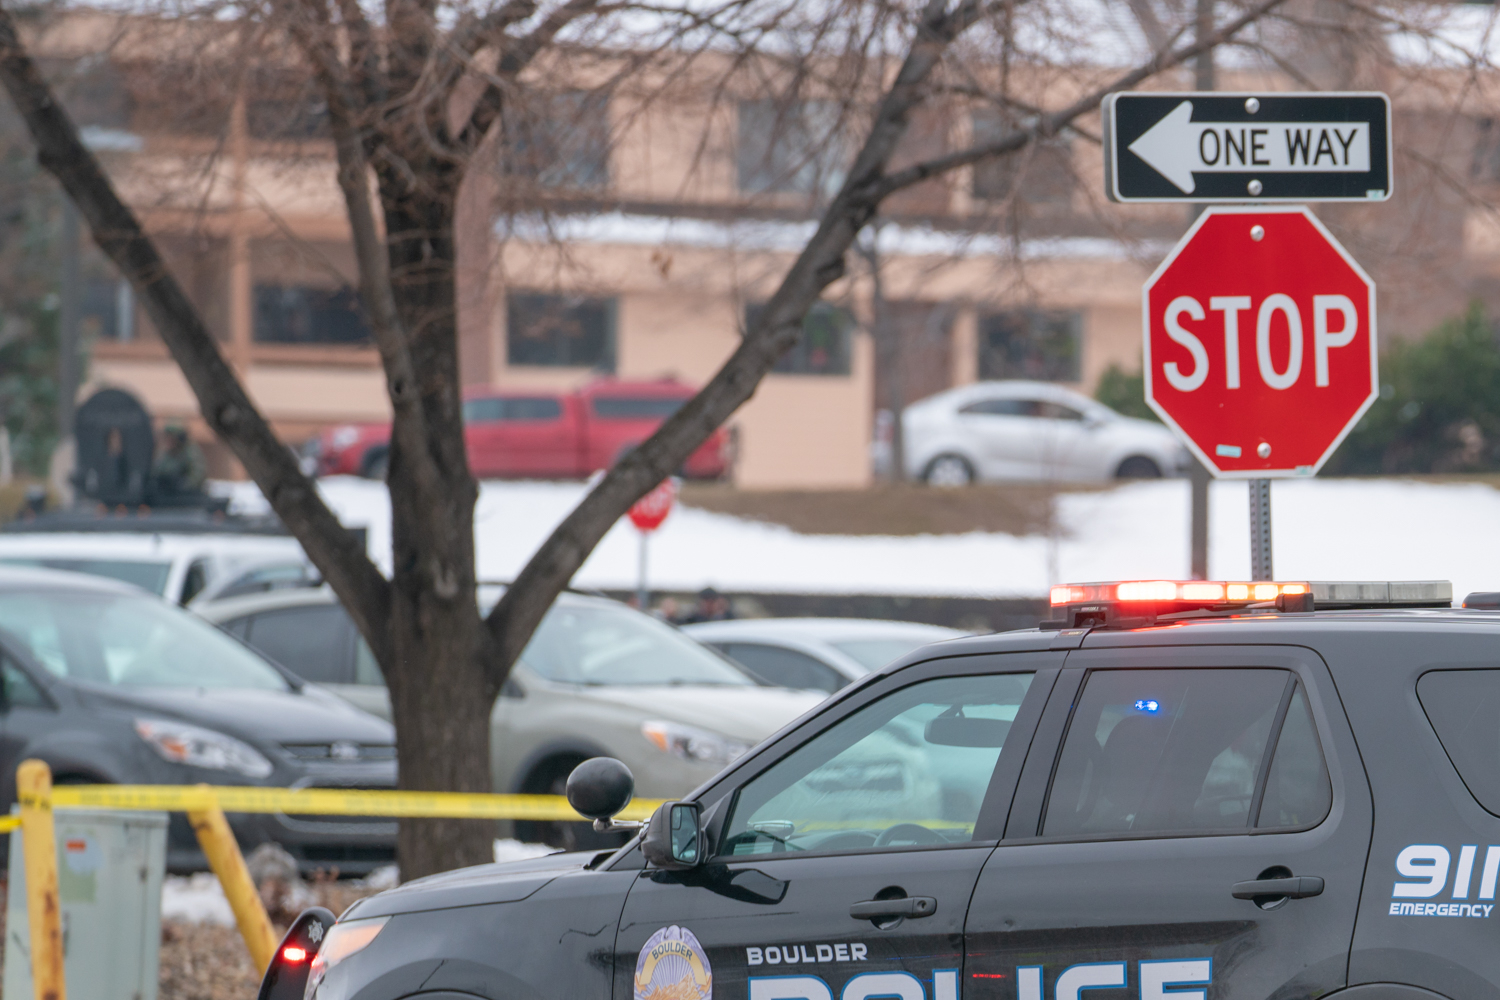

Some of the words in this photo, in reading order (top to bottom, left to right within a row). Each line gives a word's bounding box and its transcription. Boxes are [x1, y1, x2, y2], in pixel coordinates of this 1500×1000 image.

[1200, 128, 1270, 166] ONE
[1286, 128, 1358, 166] WAY
[1163, 293, 1358, 392] STOP
[1389, 902, 1495, 918] EMERGENCY
[652, 942, 693, 961] BOULDER
[746, 942, 868, 966] BOULDER
